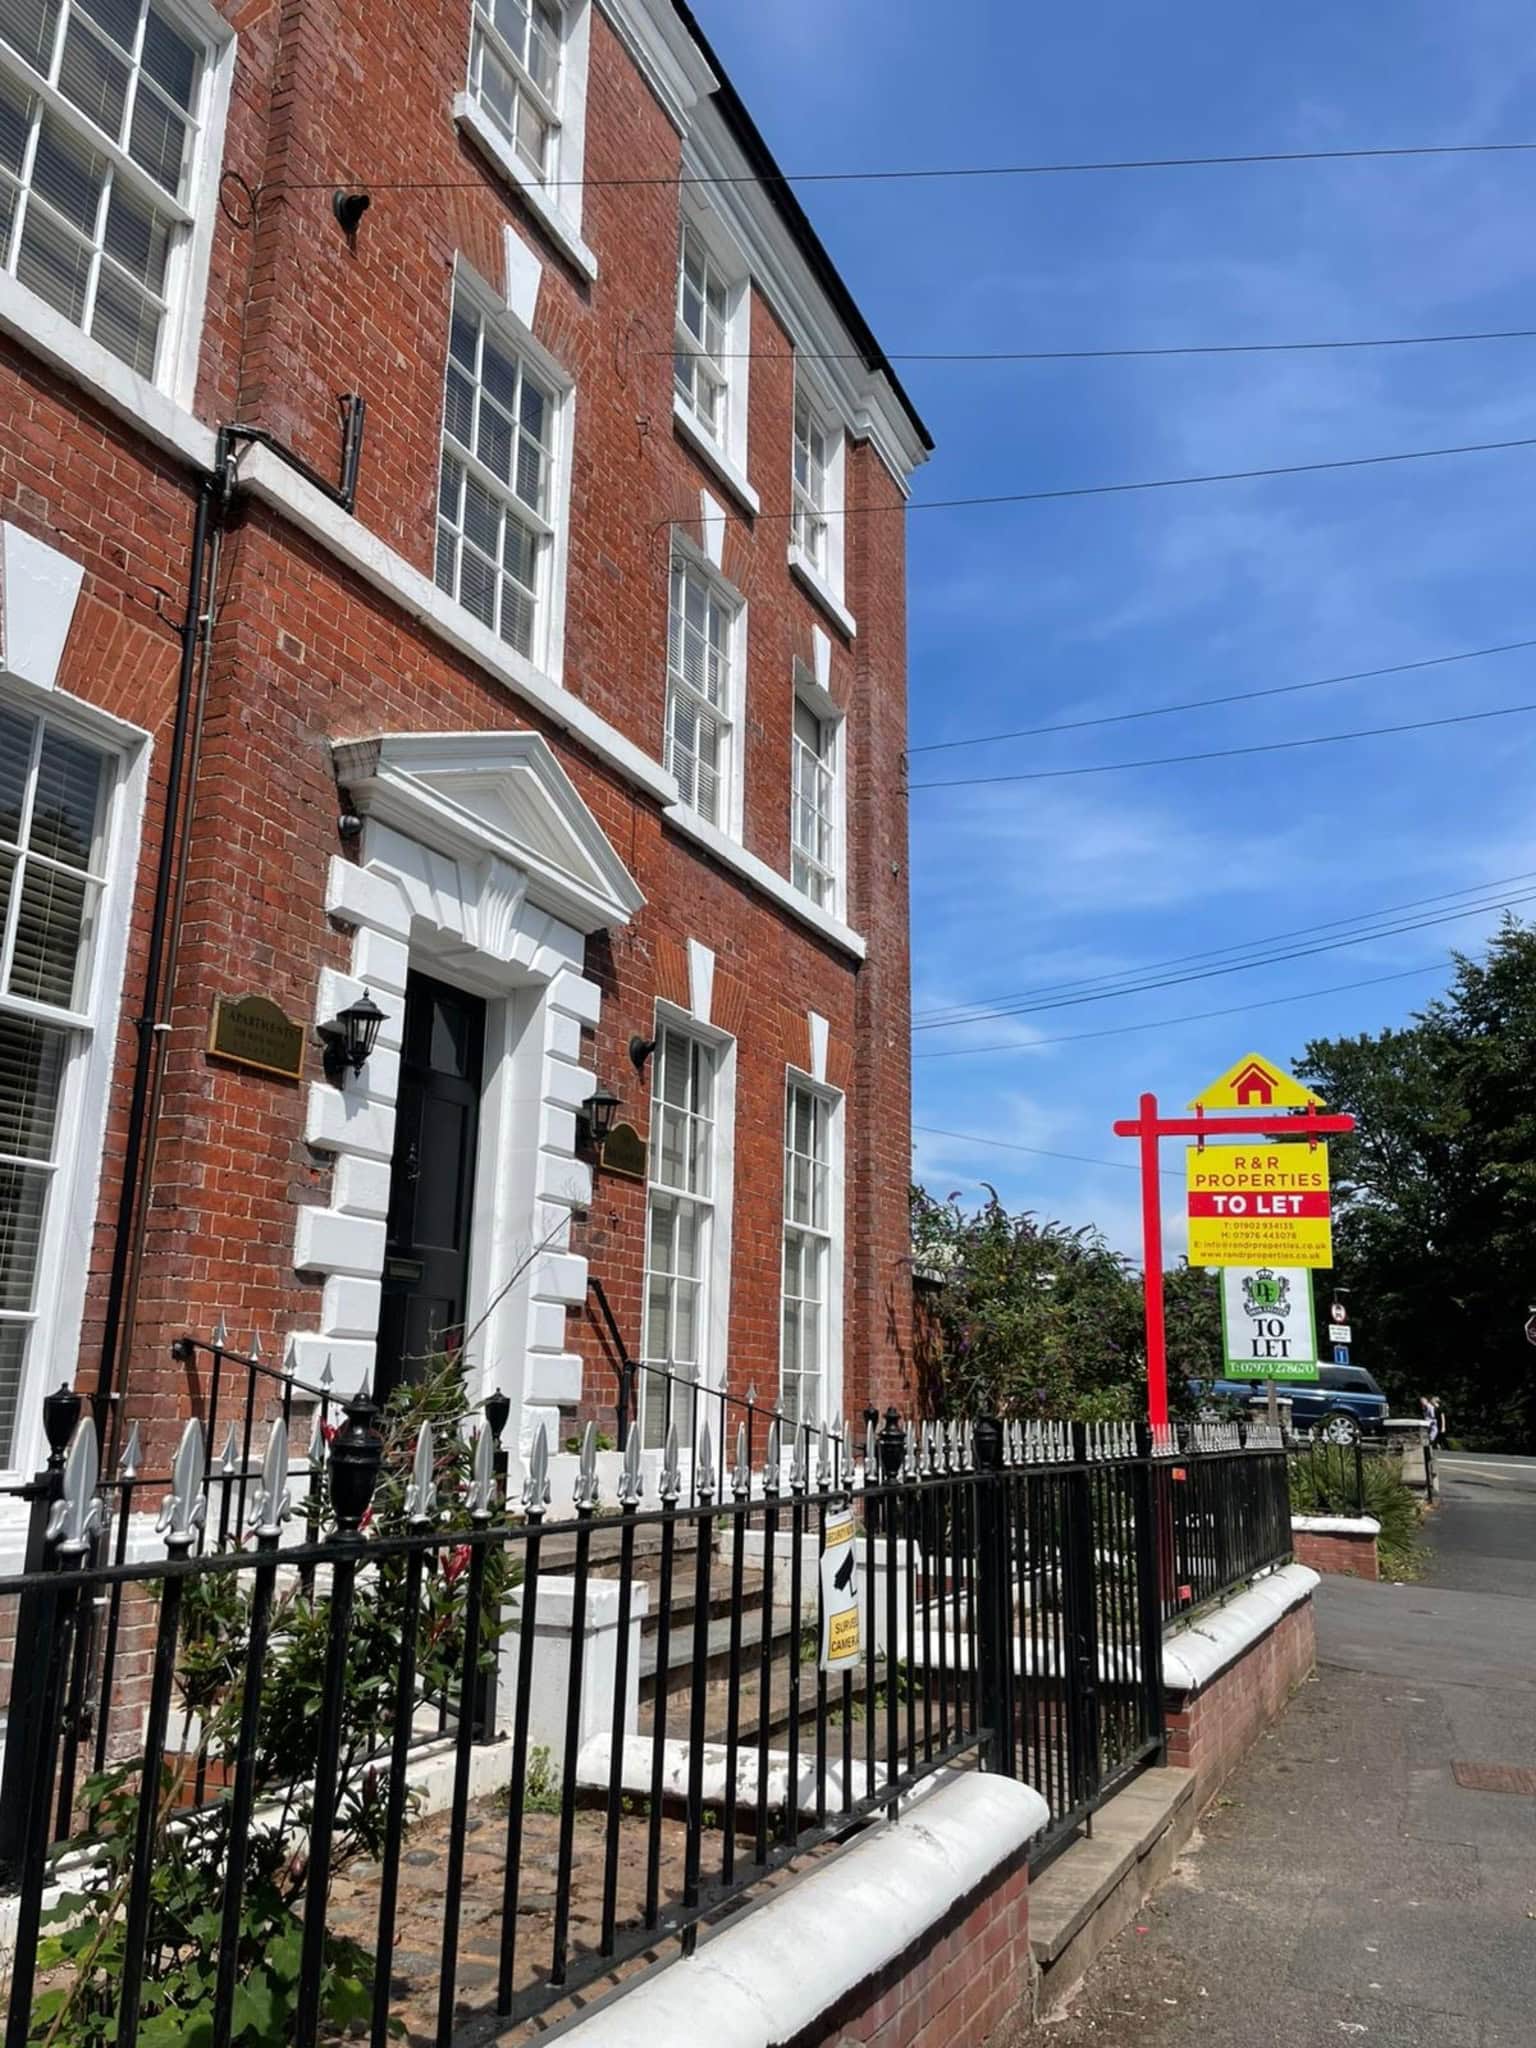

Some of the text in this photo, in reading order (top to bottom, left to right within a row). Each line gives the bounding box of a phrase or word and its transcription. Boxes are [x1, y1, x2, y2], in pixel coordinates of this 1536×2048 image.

[1235, 1157, 1279, 1169] R & R
[1196, 1174, 1322, 1187] PROPERTIES
[1213, 1195, 1303, 1214] TO LET
[1233, 1222, 1260, 1230] 01902
[1253, 1319, 1285, 1337] TO
[1251, 1339, 1292, 1358] LET
